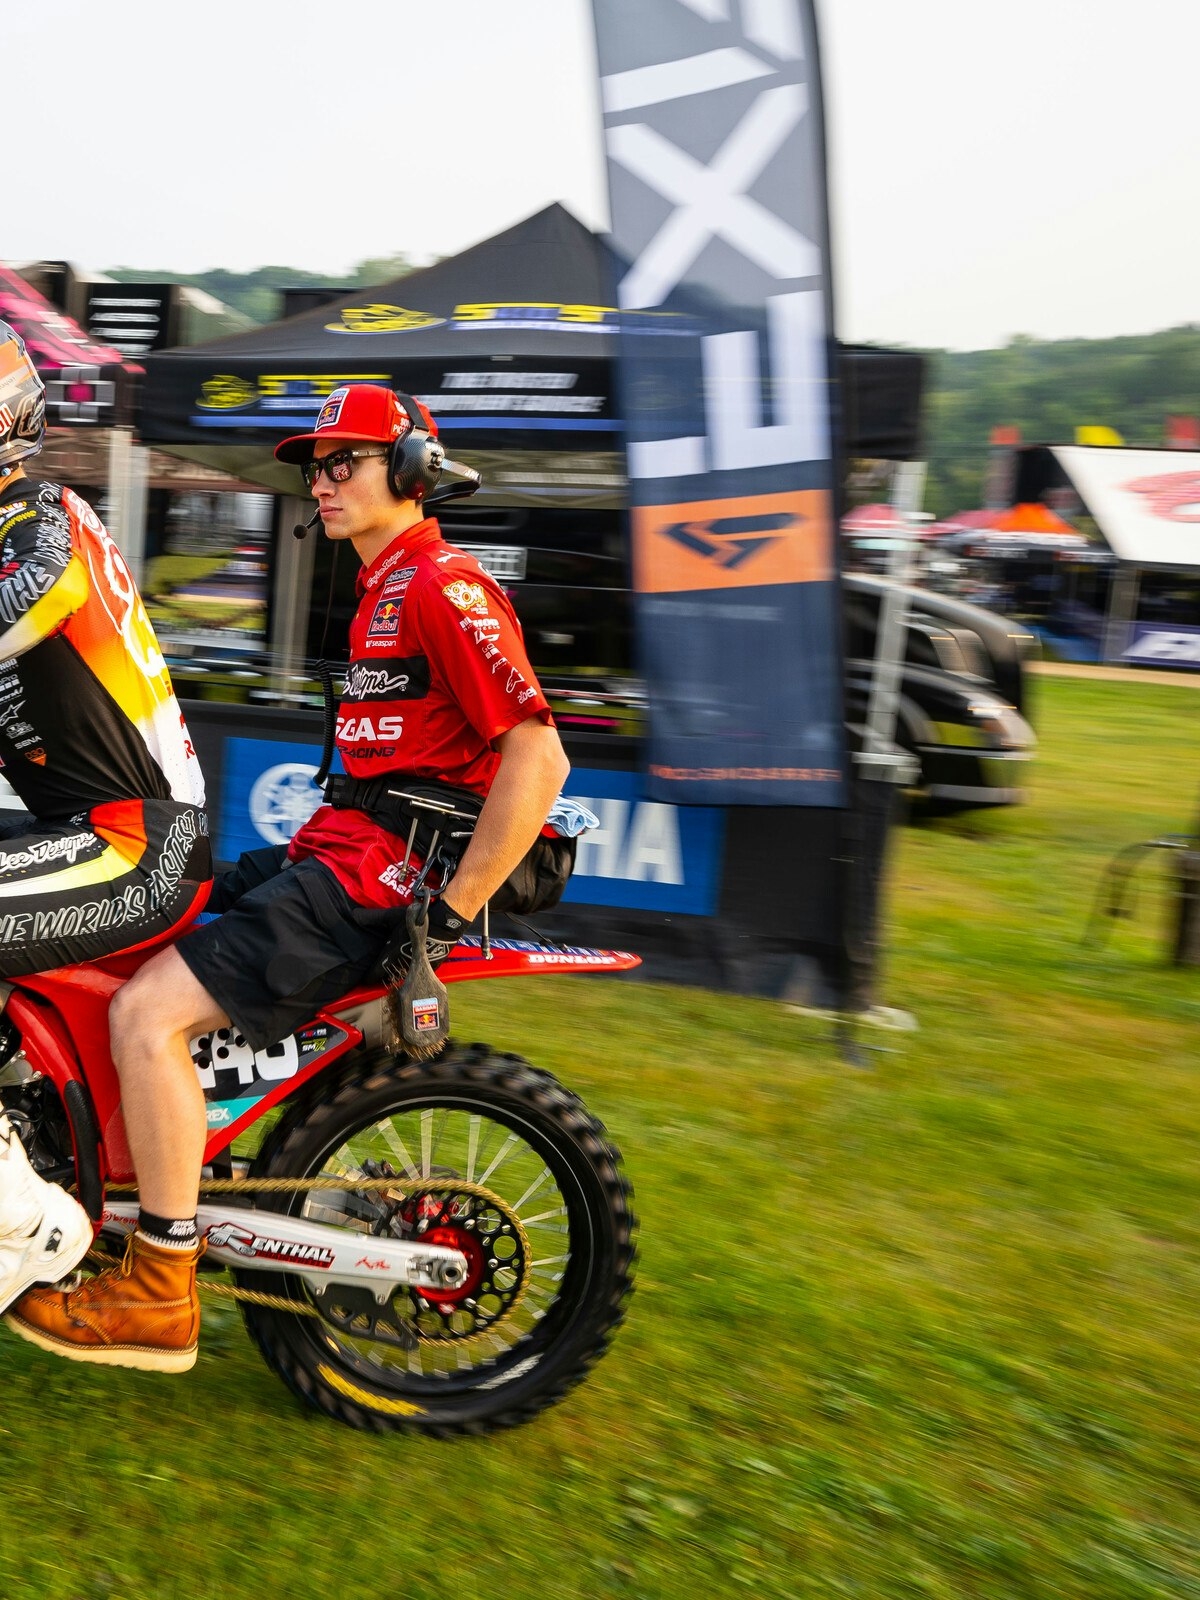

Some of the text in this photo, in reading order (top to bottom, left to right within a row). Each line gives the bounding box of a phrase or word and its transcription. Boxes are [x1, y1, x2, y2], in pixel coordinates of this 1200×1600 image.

[370, 640, 396, 648] seaspan
[14, 735, 43, 750] SENA
[29, 832, 98, 864] Designs
[378, 871, 412, 898] GAS!
[528, 953, 617, 965] DUNLOP
[112, 1213, 138, 1225] brem
